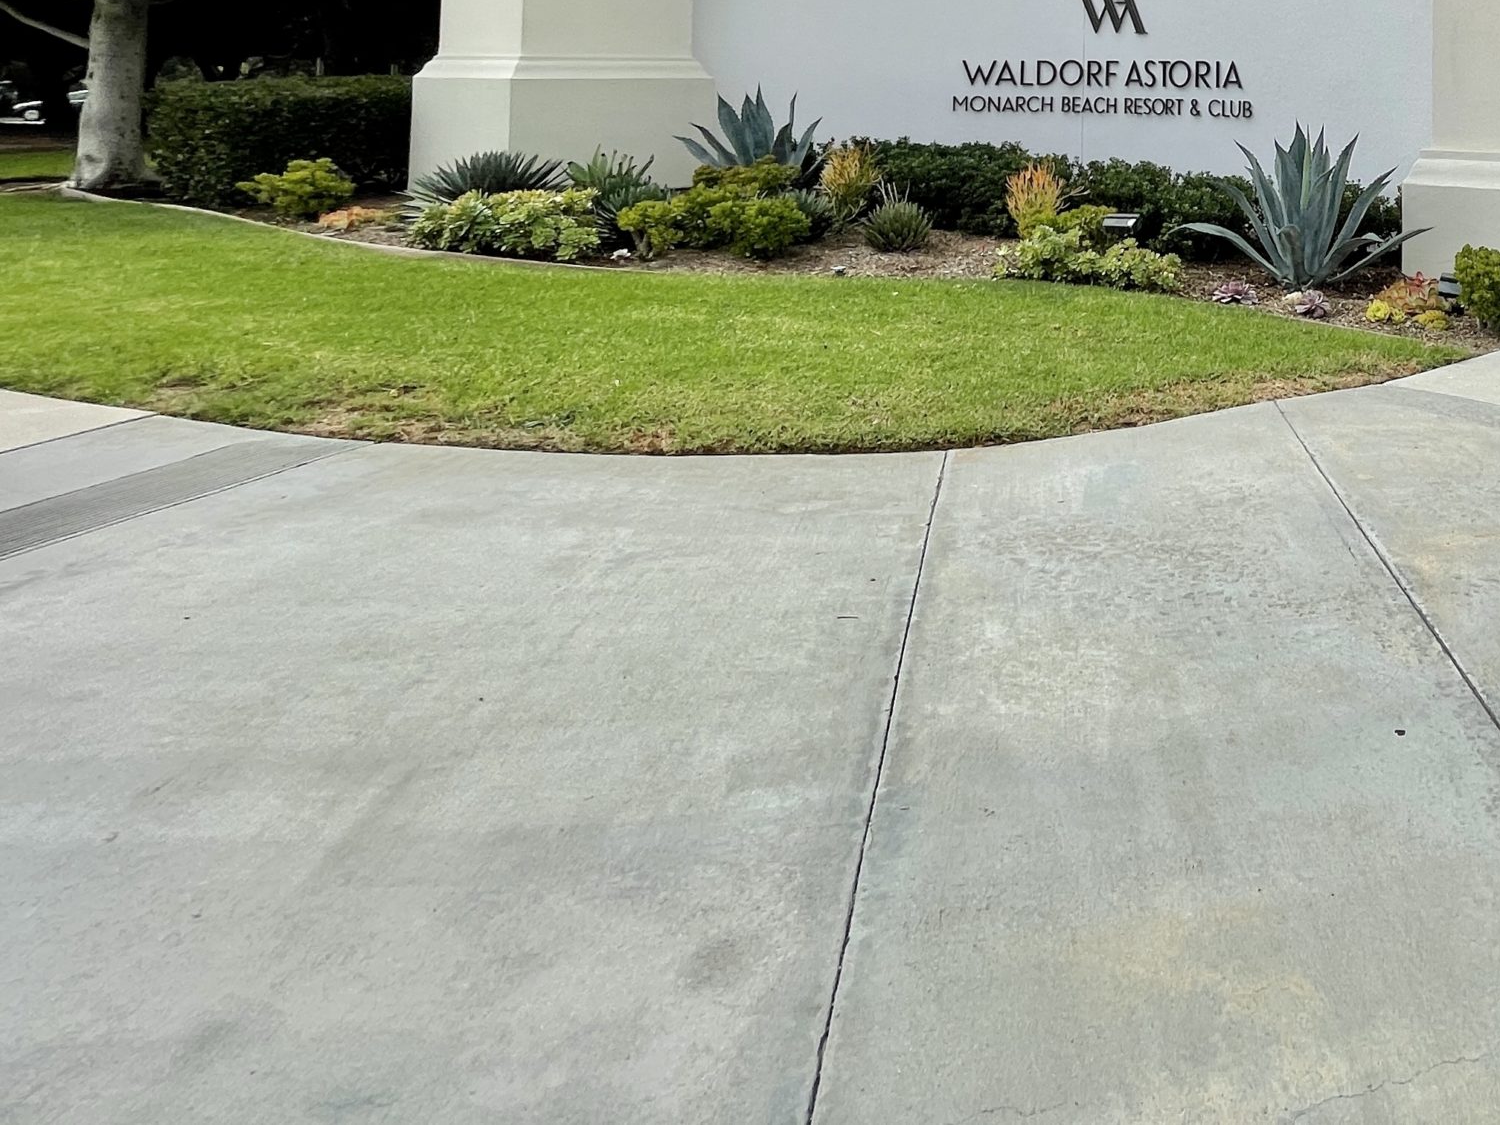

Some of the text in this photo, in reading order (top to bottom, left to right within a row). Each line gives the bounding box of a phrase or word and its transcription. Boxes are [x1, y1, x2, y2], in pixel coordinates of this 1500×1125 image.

[962, 59, 1243, 89] WALDORF ASTORIA
[952, 95, 1253, 118] MONARCH BEACH RESORT & CLUB
